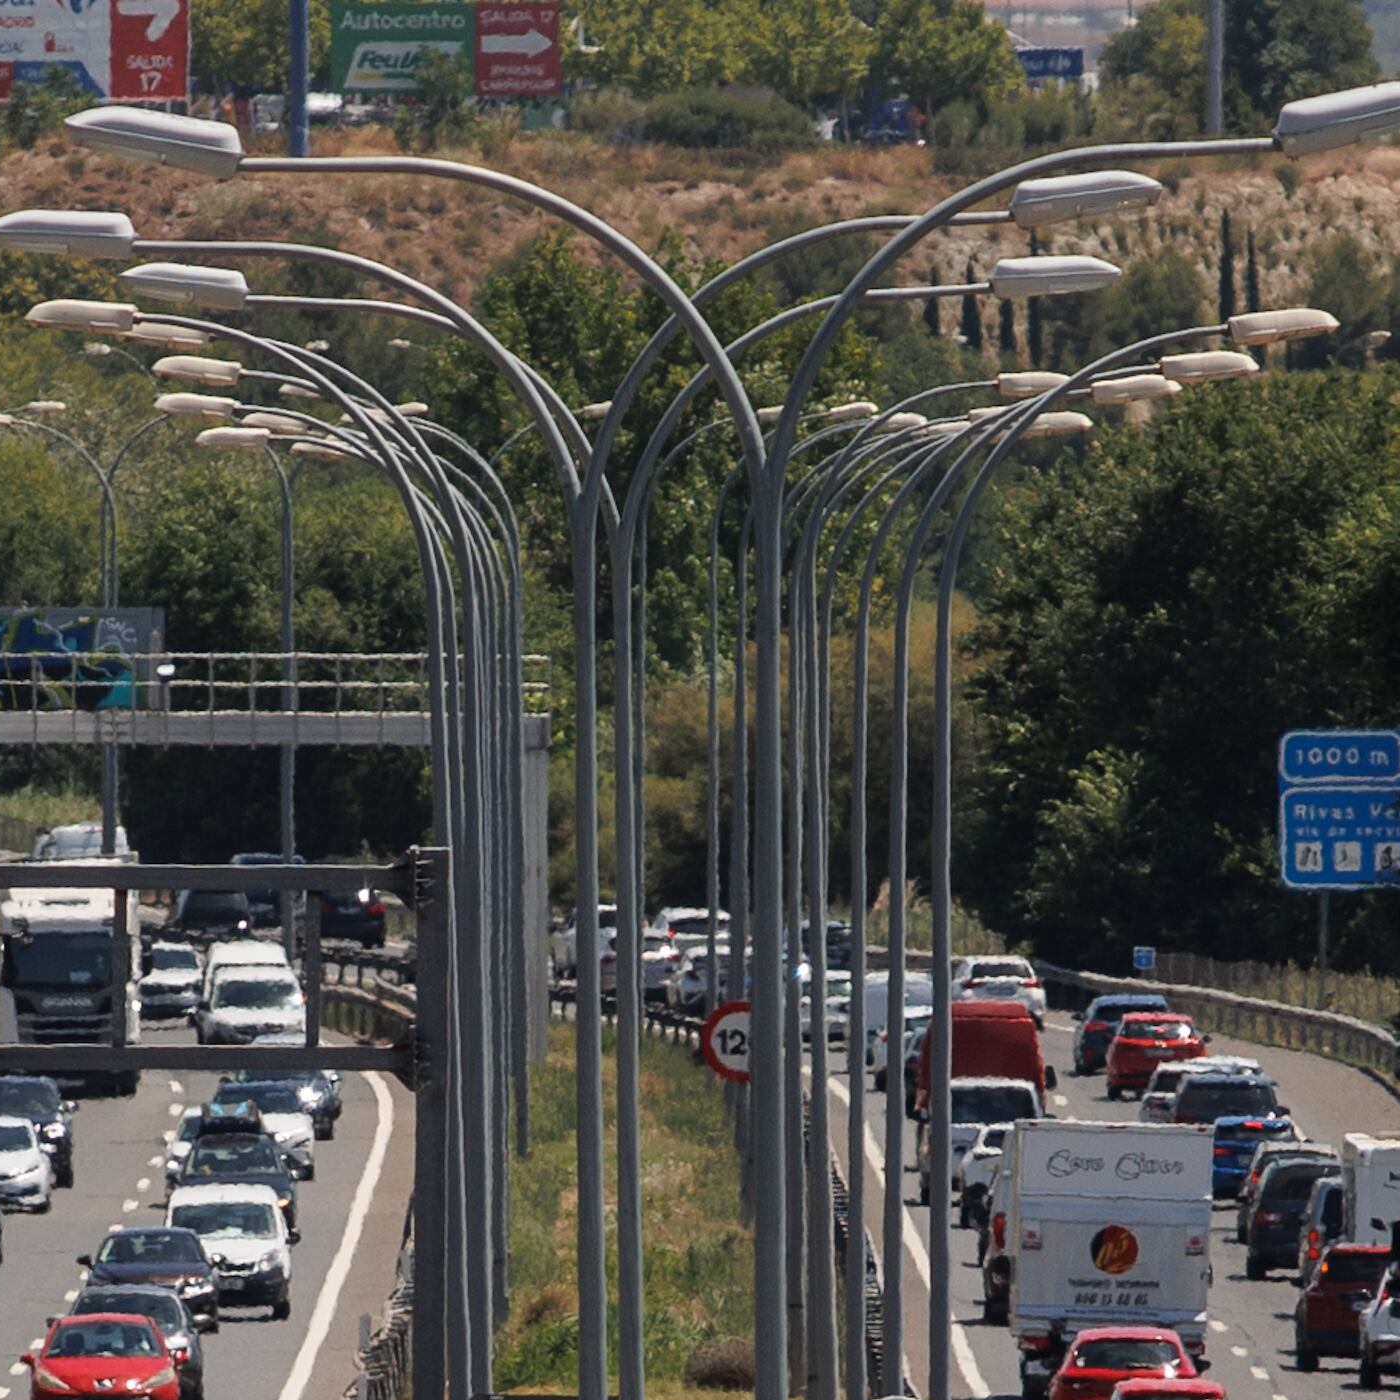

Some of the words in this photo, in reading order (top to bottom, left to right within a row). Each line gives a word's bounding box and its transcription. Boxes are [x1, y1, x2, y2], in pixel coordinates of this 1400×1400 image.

[340, 12, 465, 29] Autocentro
[126, 54, 175, 70] SALIDA
[140, 73, 162, 91] 17
[1296, 747, 1360, 765] 1000
[1370, 750, 1390, 766] m
[1293, 804, 1356, 820] Rivas
[715, 1029, 748, 1055] 12
